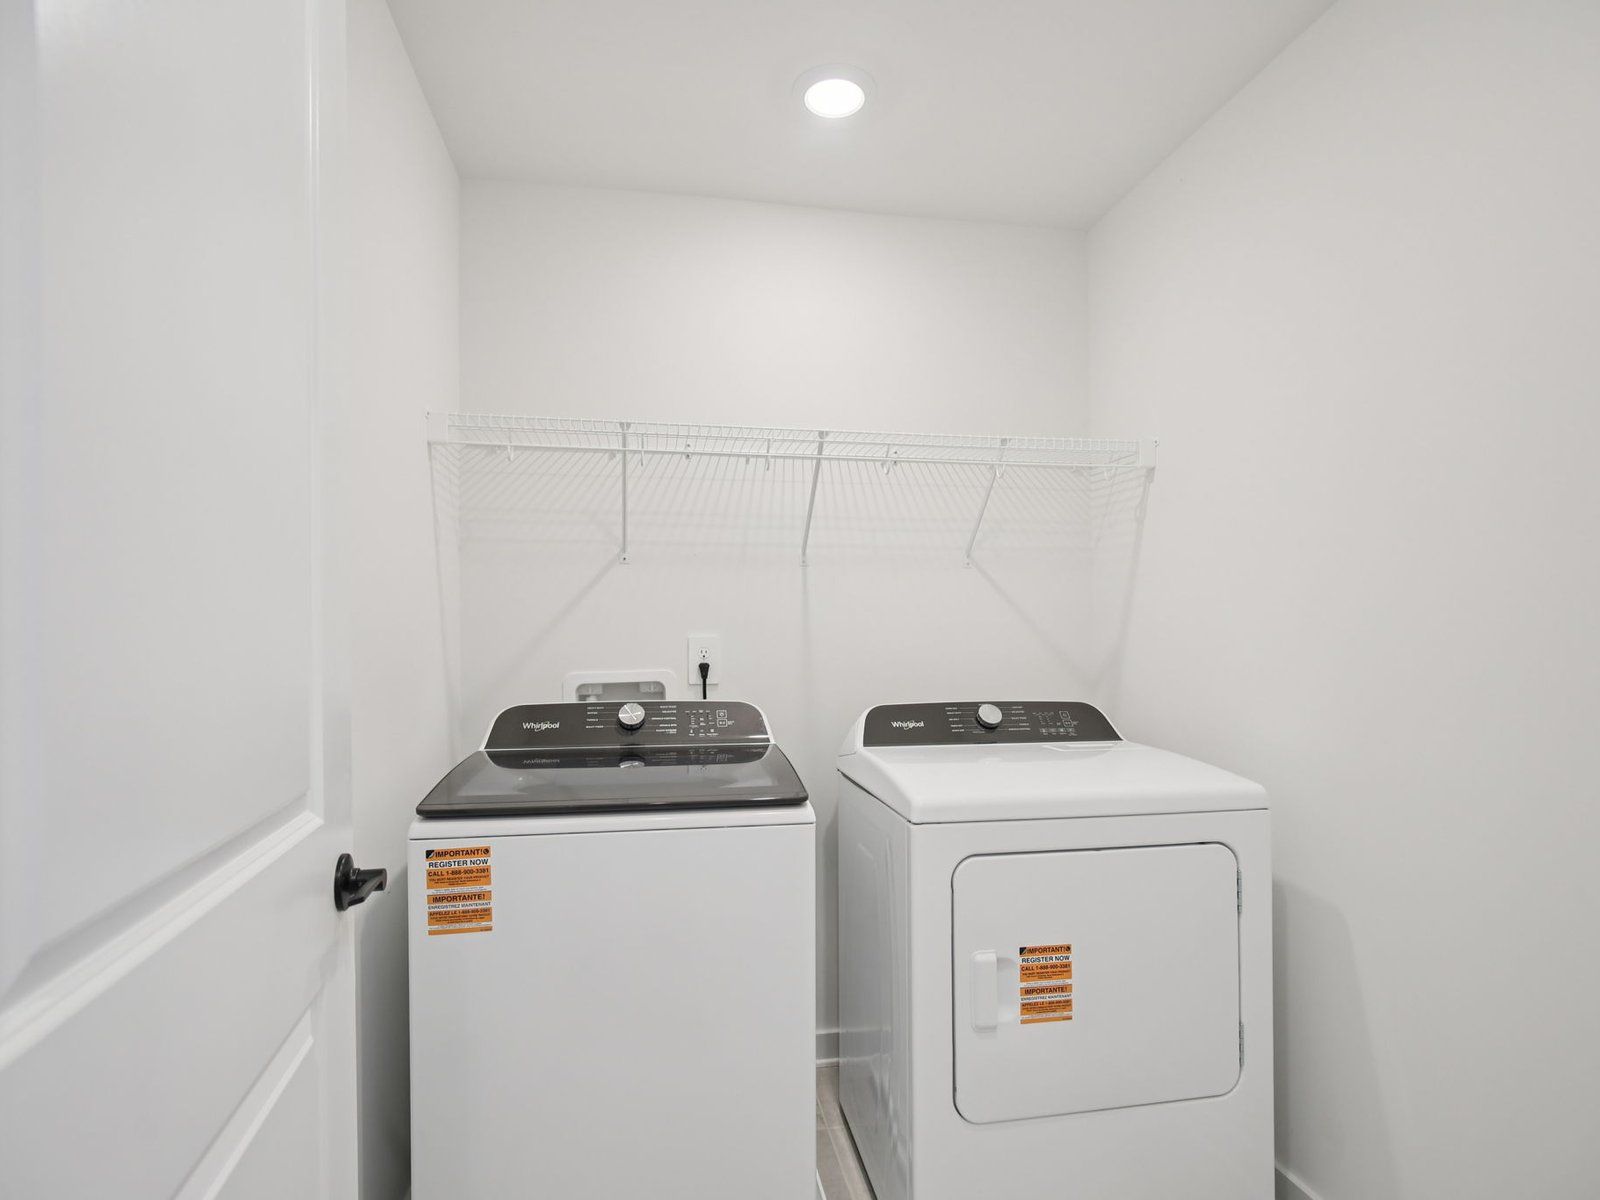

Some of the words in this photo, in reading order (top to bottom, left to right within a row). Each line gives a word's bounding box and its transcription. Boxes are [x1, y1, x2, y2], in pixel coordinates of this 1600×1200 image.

[522, 721, 560, 732] Whirlpool
[890, 720, 925, 730] Whirlpool
[435, 849, 482, 857] IMPORTANT!
[428, 860, 468, 868] REGISTER
[469, 858, 489, 866] NOW
[433, 894, 485, 903] IMPORTANTE!
[1025, 987, 1067, 995] IMPORTANTE!
